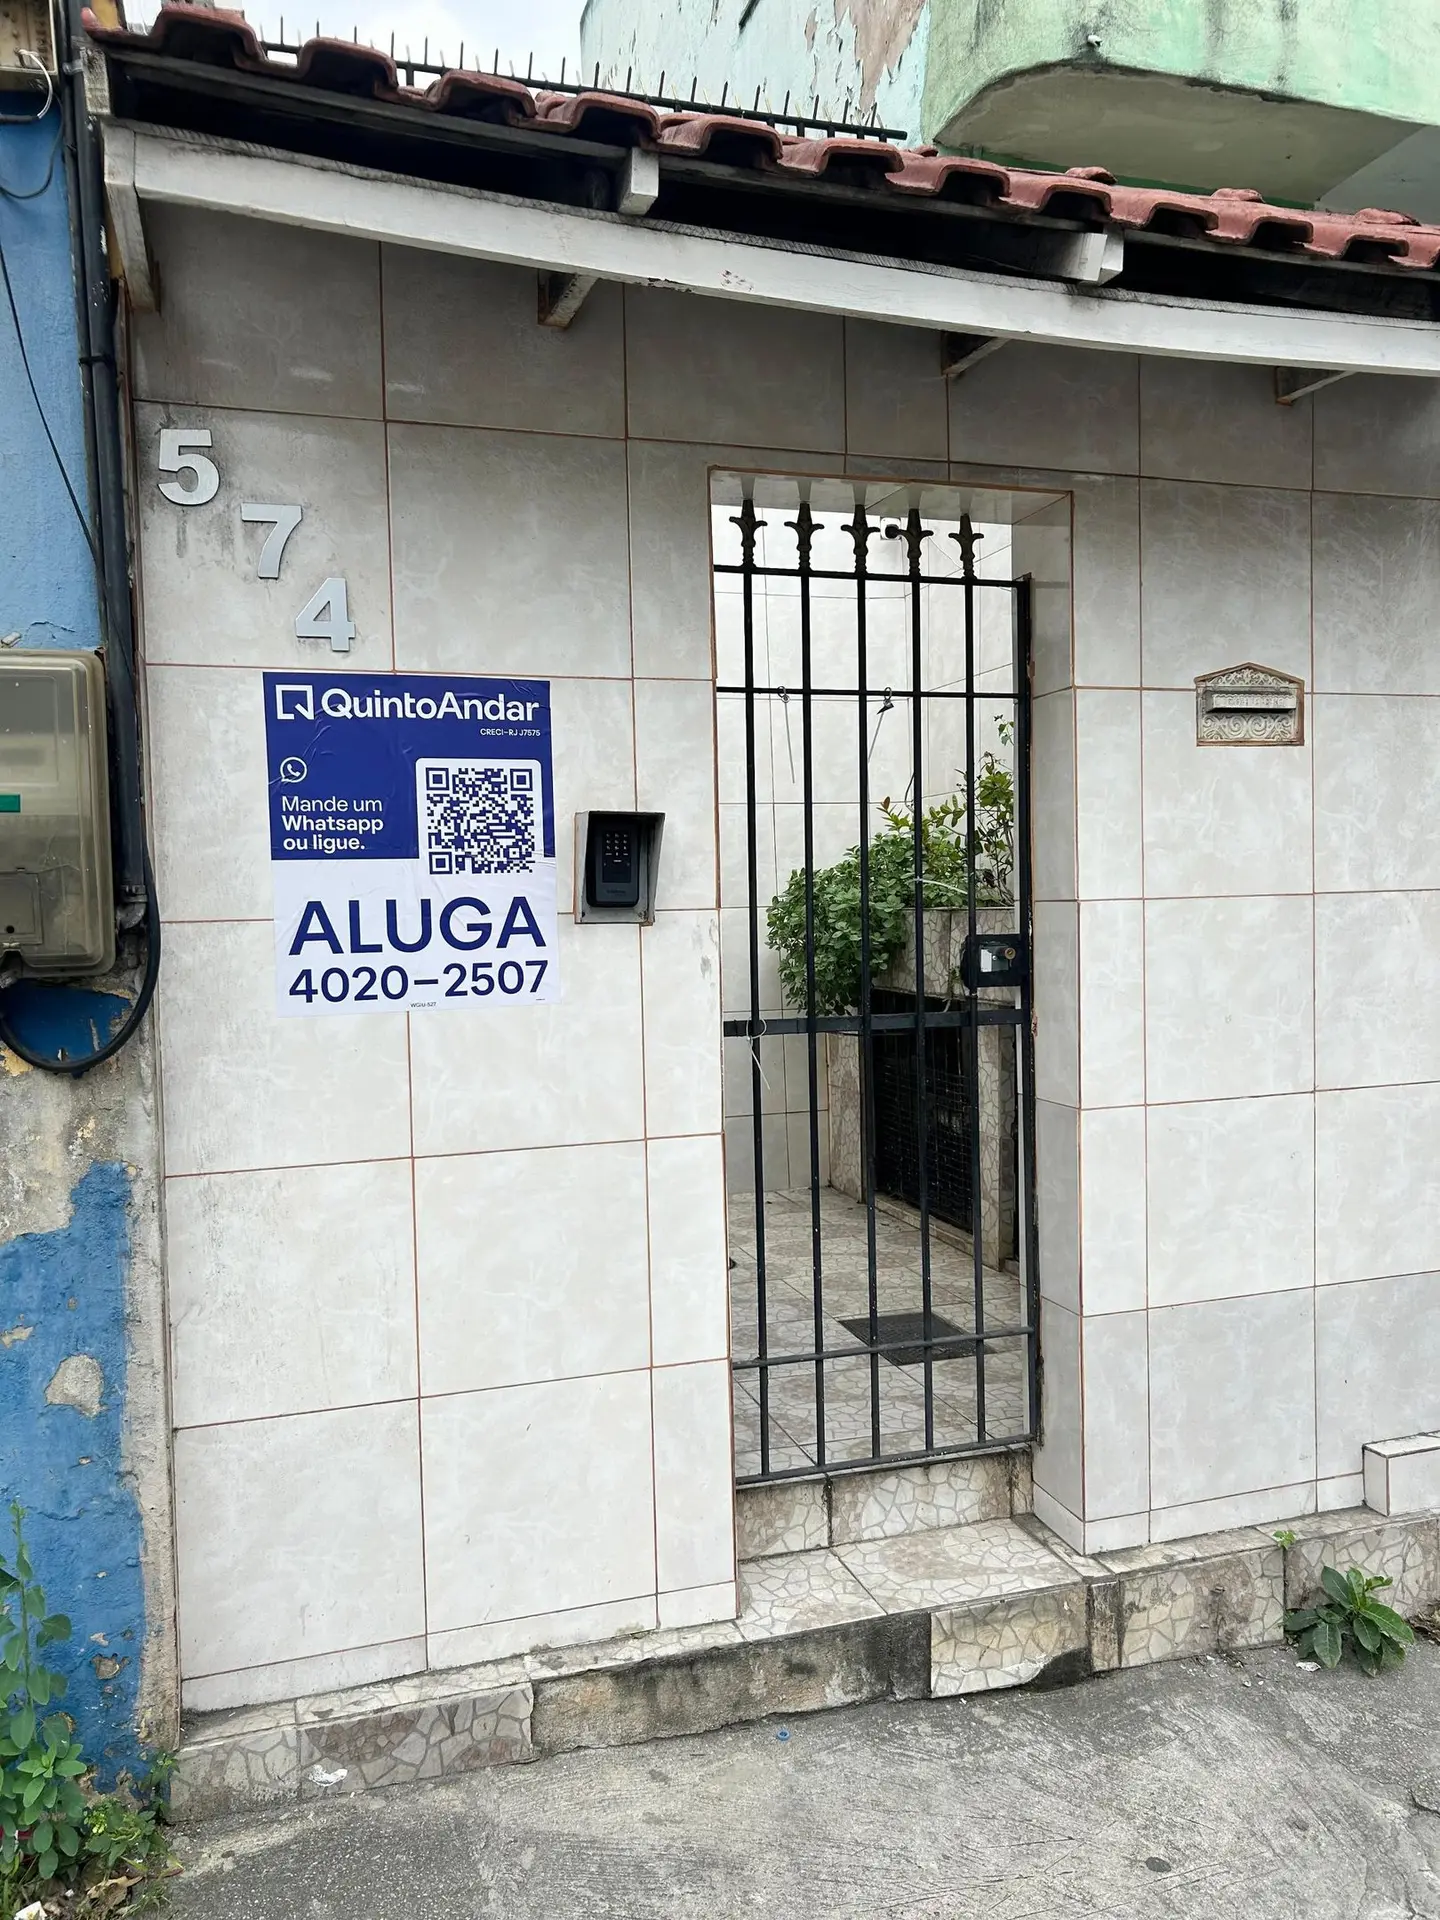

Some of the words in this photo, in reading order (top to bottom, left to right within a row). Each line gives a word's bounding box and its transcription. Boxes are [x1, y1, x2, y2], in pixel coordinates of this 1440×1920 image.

[321, 688, 539, 721] QuintoAndar
[480, 728, 518, 736] CRECI-RJ
[519, 729, 541, 737] J7575
[282, 796, 348, 812] Mande
[353, 798, 382, 812] um
[281, 815, 384, 834] Whatsapp
[283, 836, 308, 850] ou
[312, 834, 366, 854] ligue.
[288, 896, 547, 956] ALUGA
[289, 960, 549, 1003] 4020-2507
